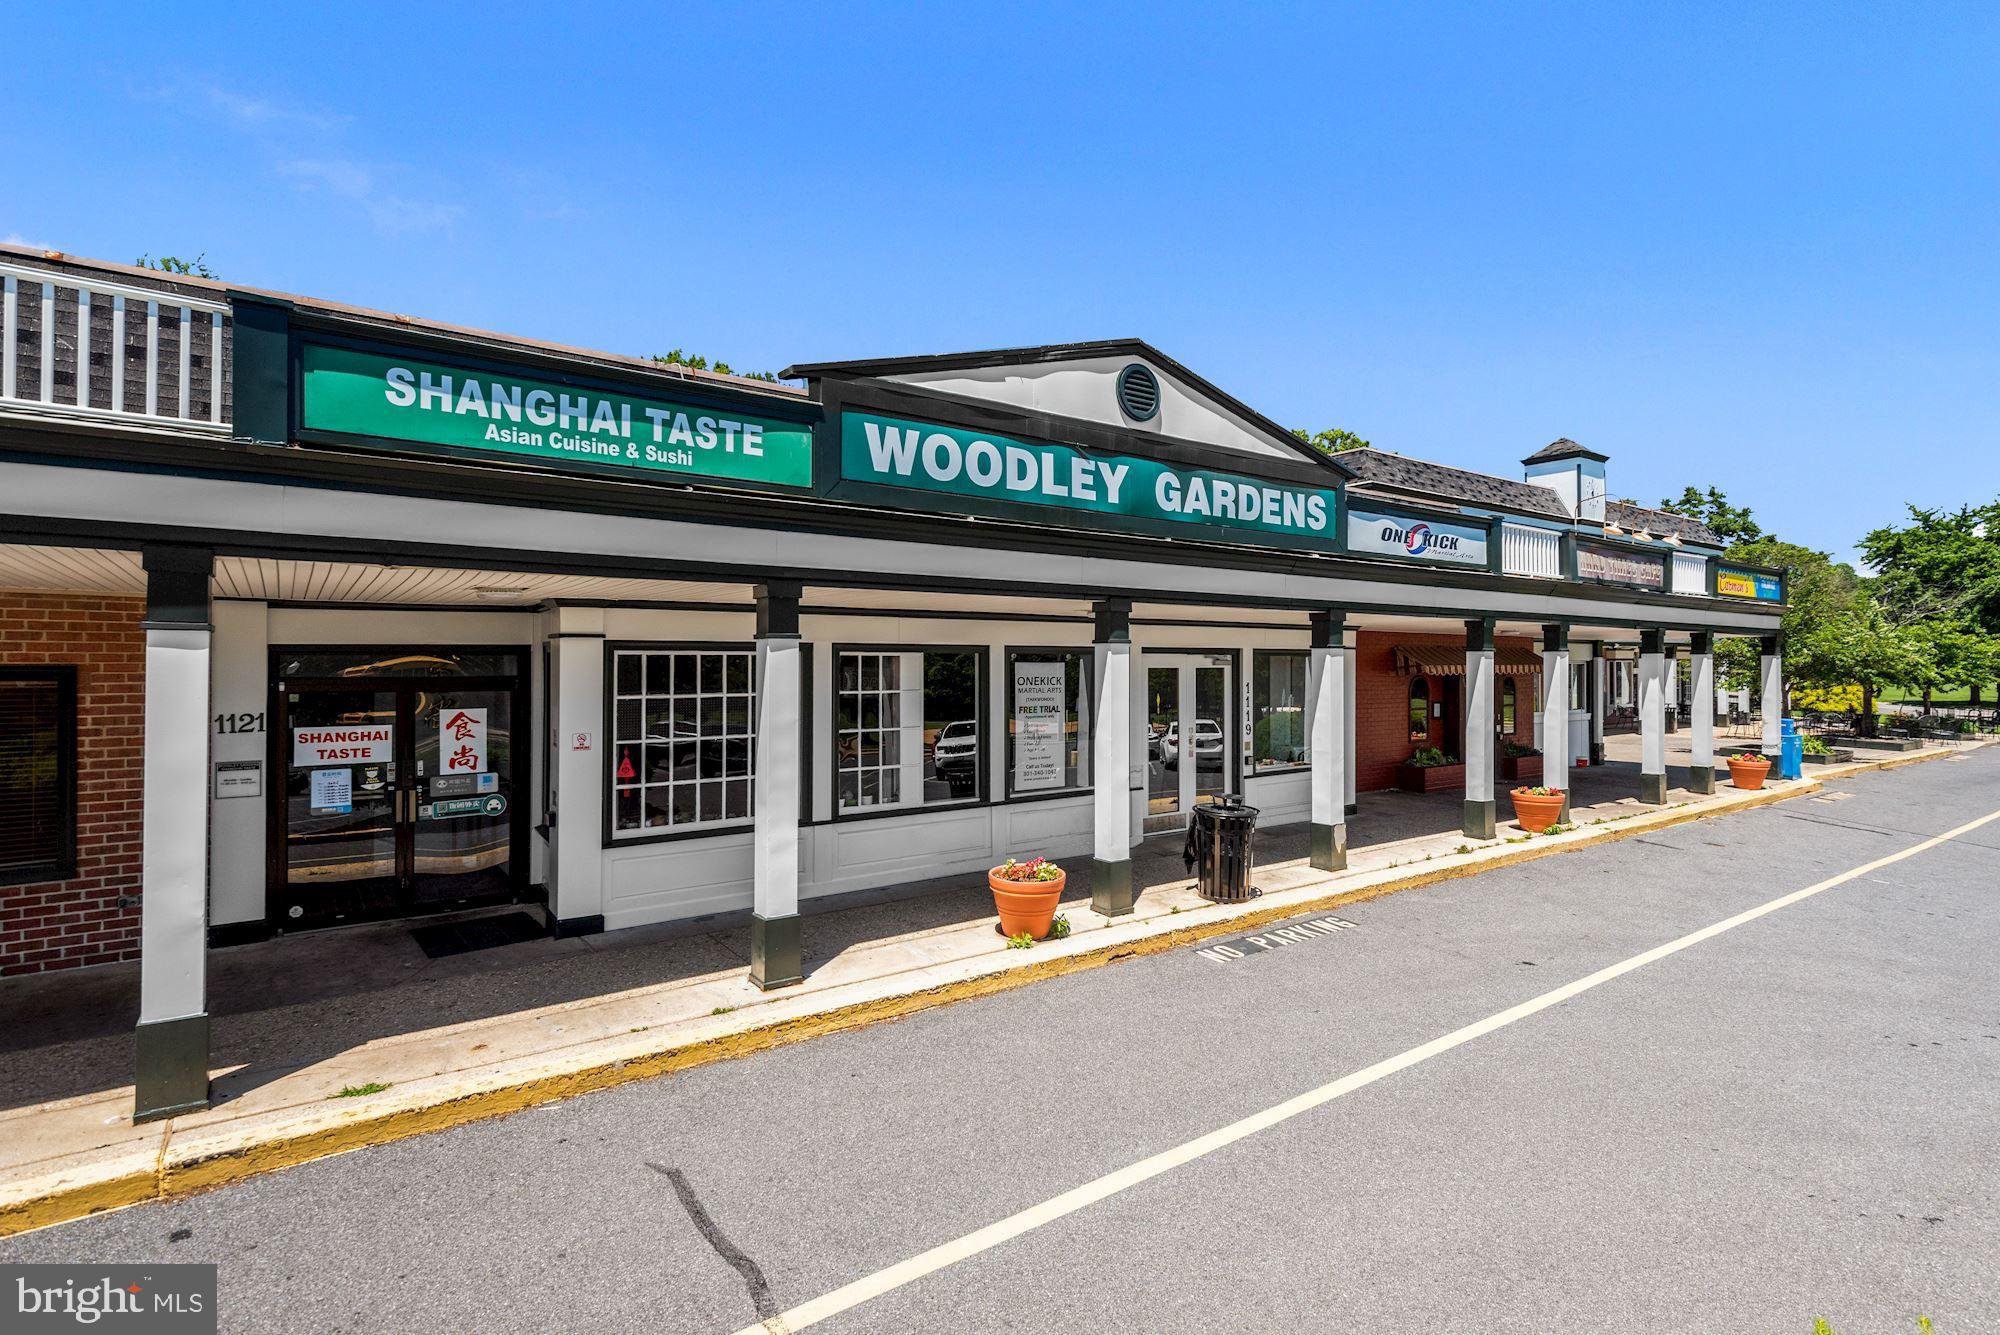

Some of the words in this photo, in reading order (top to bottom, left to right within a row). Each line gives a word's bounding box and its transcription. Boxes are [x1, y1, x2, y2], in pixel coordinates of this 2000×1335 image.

[385, 368, 631, 438] SHANGHAI
[646, 408, 764, 457] TASTE
[485, 423, 543, 447] Asian
[549, 431, 620, 458] Cuisine
[626, 443, 640, 459] &
[646, 445, 693, 466] Sushi
[864, 422, 1130, 504] WOODLEY
[1155, 471, 1327, 531] GARDENS
[1381, 527, 1411, 544] ONE
[1422, 532, 1459, 551] KICK
[1017, 676, 1063, 686] ONEKICK
[1018, 705, 1038, 714] FREE
[1040, 705, 1061, 713] TRIAL
[214, 712, 266, 734] 1121
[298, 730, 389, 744] SHANGHAI
[316, 747, 372, 760] TASTE
[1196, 945, 1246, 965] NO
[1245, 916, 1358, 951] PARKING
